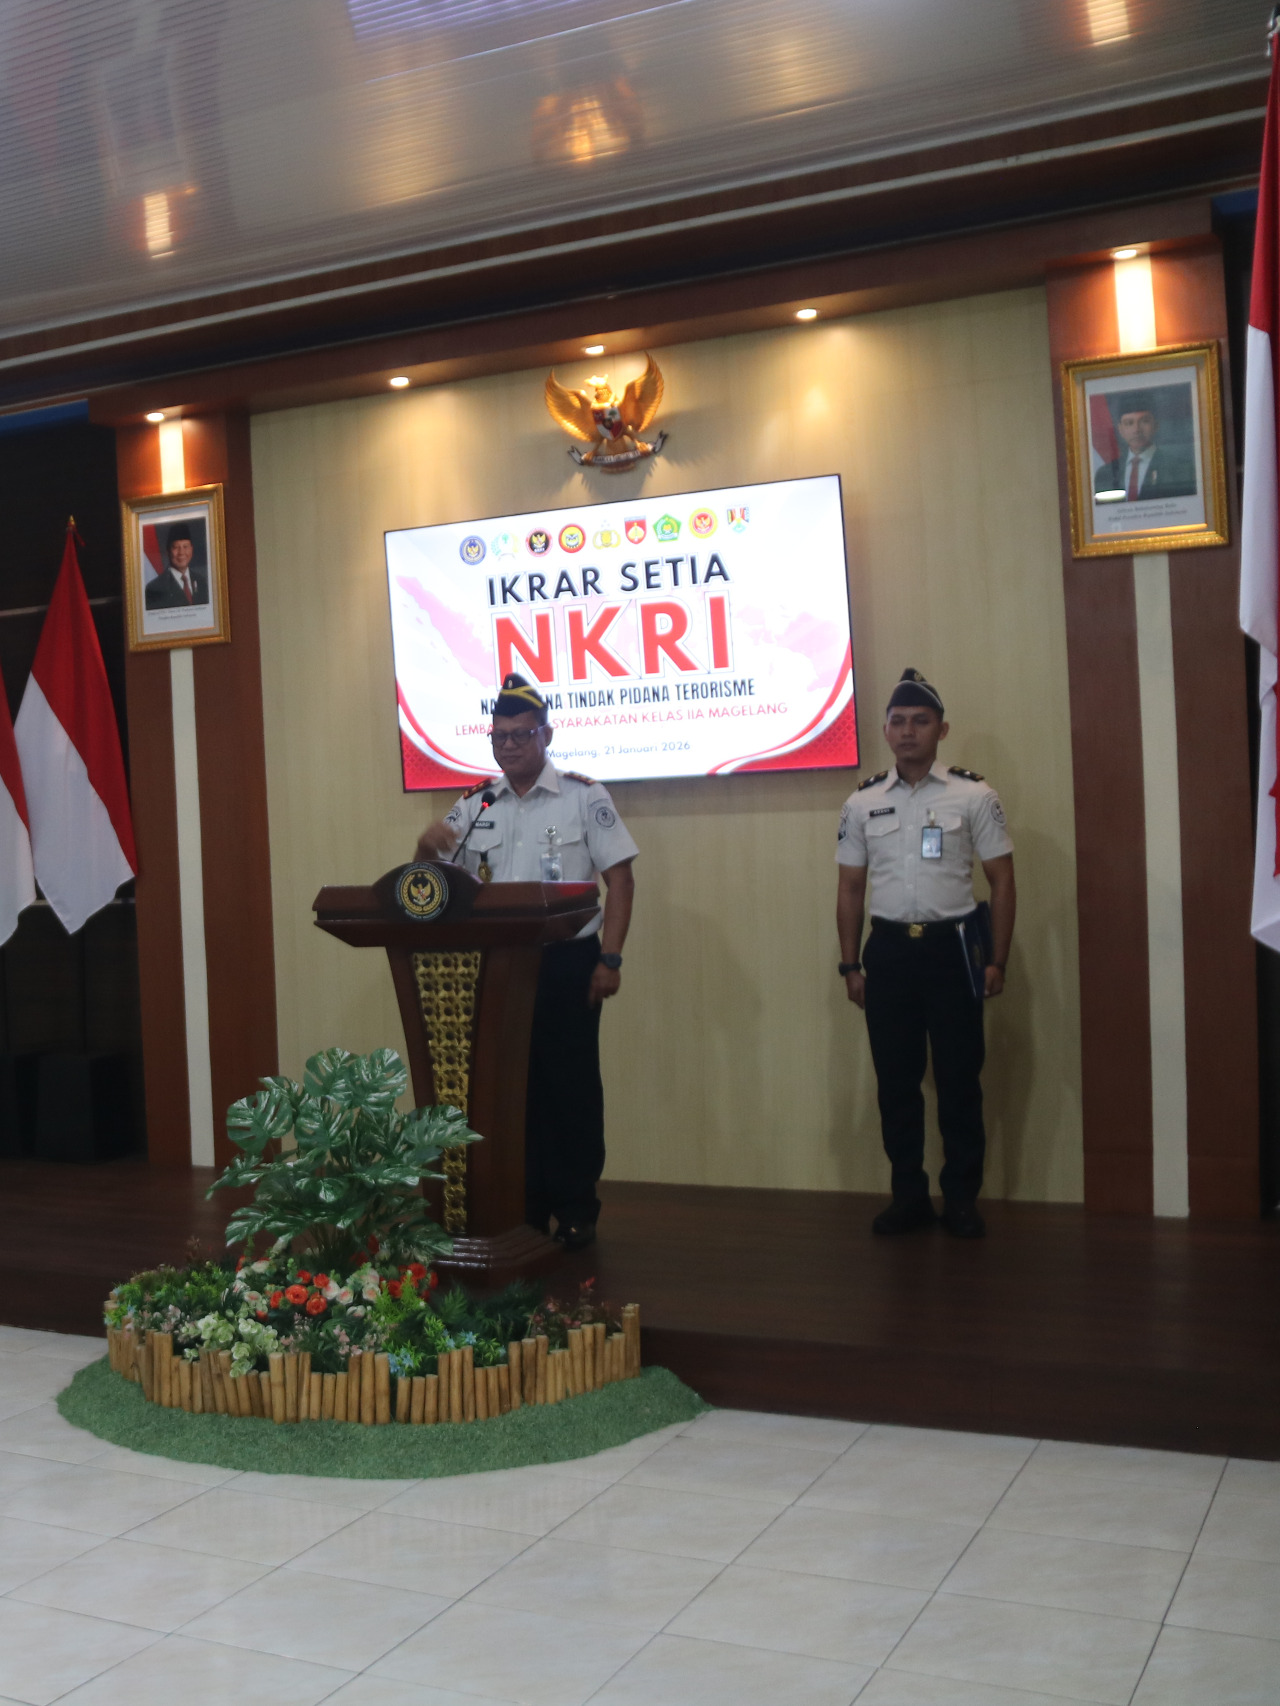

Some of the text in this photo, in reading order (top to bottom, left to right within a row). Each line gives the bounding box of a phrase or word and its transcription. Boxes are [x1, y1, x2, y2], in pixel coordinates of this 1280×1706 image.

[488, 552, 731, 606] IKRAR SETIA
[495, 595, 730, 685] NKRI
[567, 688, 615, 709] TINDAK
[619, 685, 671, 705] PIDANA
[675, 678, 755, 700] TERORISME
[455, 702, 788, 736] LEMBA SYARAKATAN KELAS IIA MAGELANG
[604, 745, 616, 755] 21
[618, 745, 658, 754] Januari
[661, 741, 691, 752] 2026
